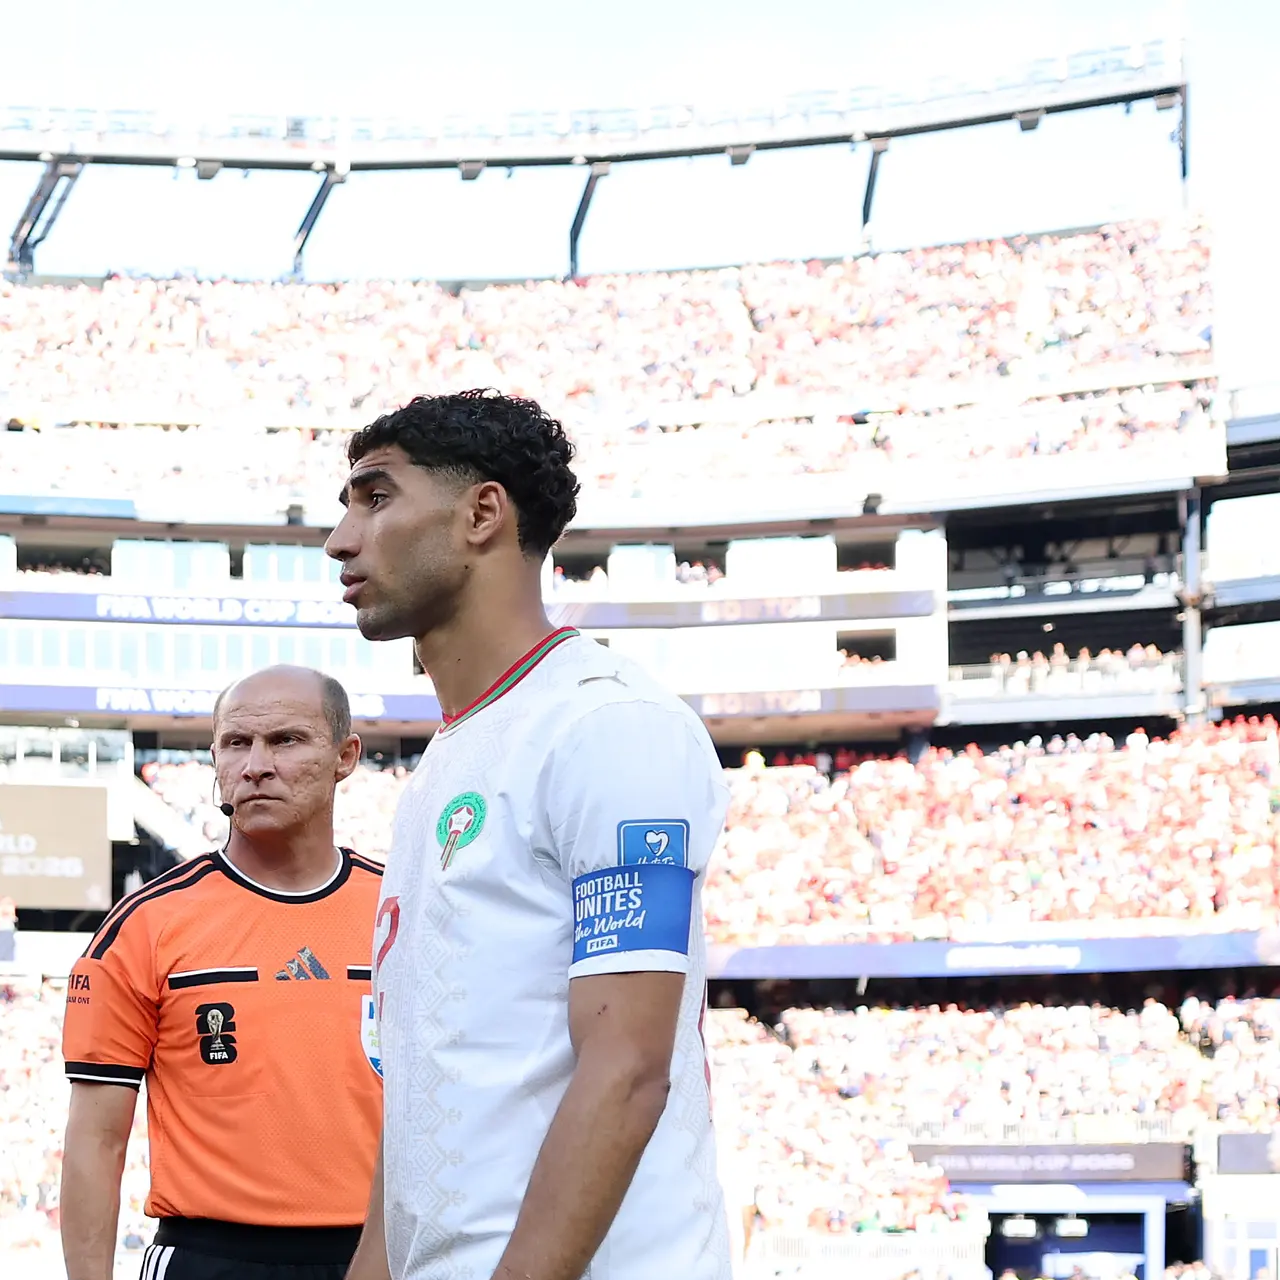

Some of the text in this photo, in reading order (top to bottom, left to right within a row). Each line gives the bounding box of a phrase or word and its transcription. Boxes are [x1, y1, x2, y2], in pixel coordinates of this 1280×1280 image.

[152, 690, 220, 714] WOR
[576, 871, 643, 900] FOOTBALL
[576, 888, 643, 922] UNITES
[575, 910, 646, 943] the World
[589, 938, 614, 950] FIFA
[69, 975, 90, 990] IFA
[209, 1051, 228, 1060] FIFA
